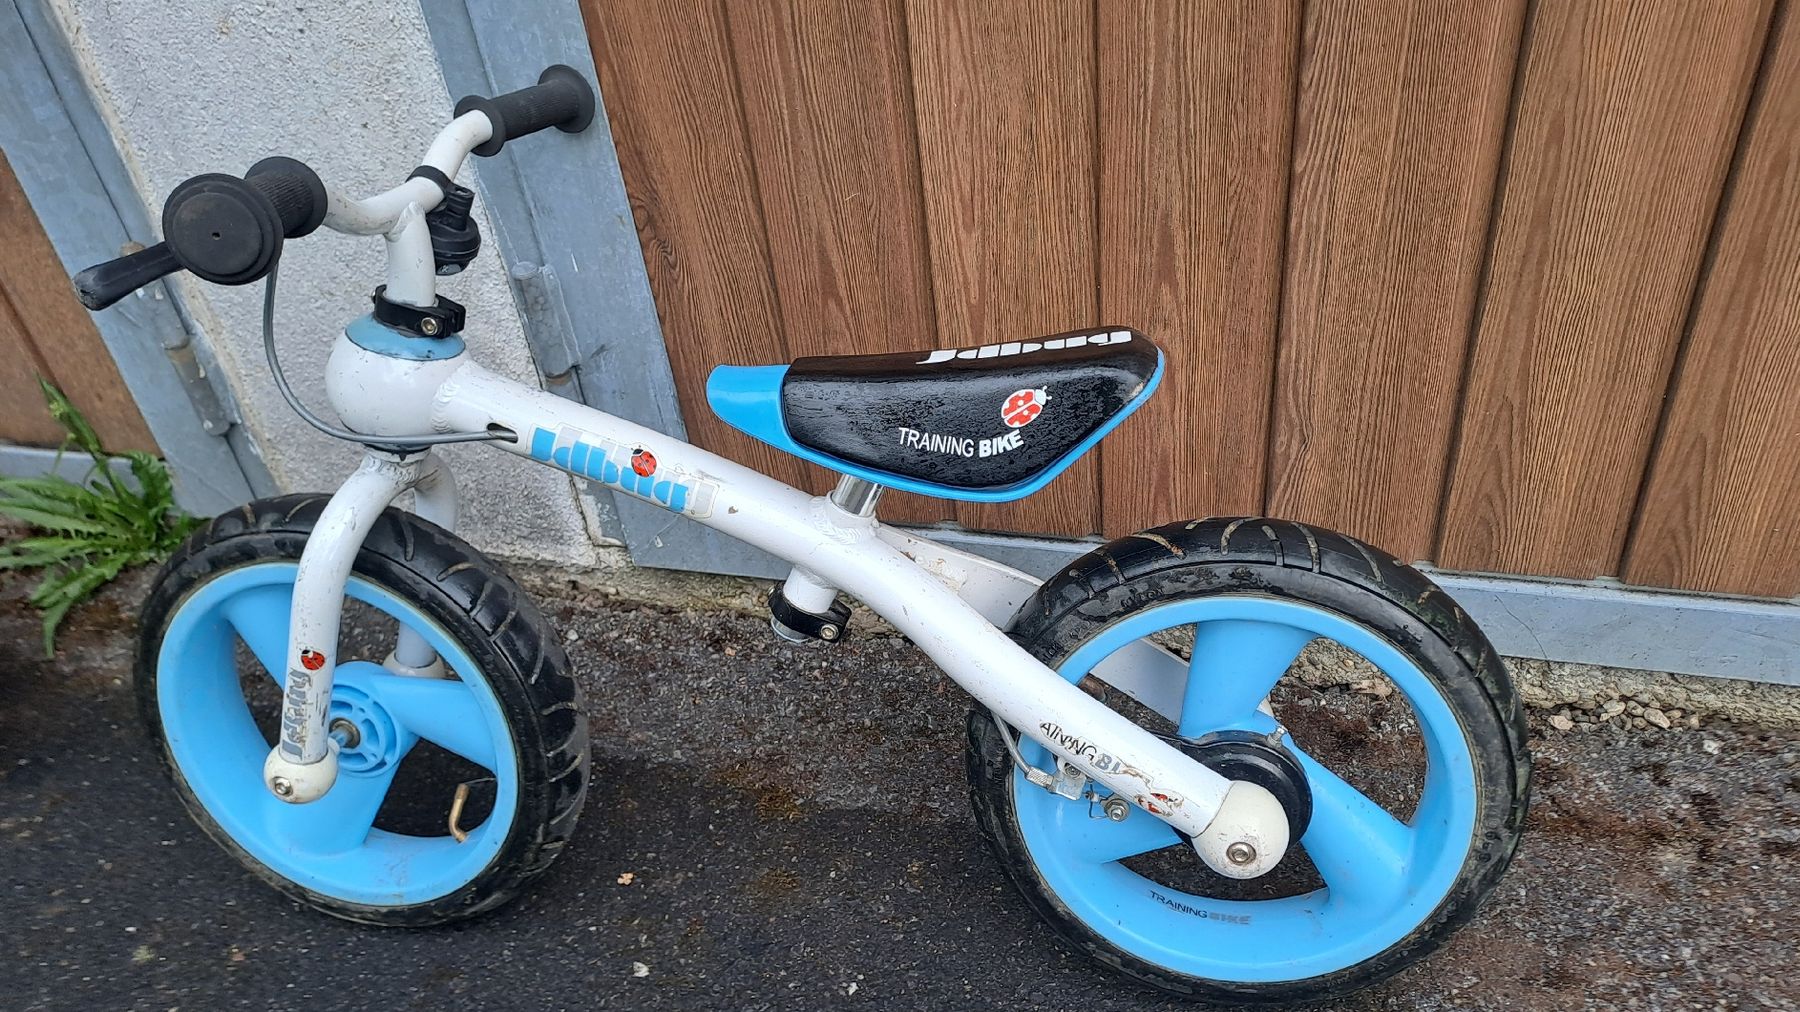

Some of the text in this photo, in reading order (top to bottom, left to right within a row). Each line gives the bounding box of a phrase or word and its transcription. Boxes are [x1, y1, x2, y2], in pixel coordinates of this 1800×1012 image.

[898, 426, 1025, 458] TRAINING BIKE
[1149, 890, 1208, 919] TRAINING
